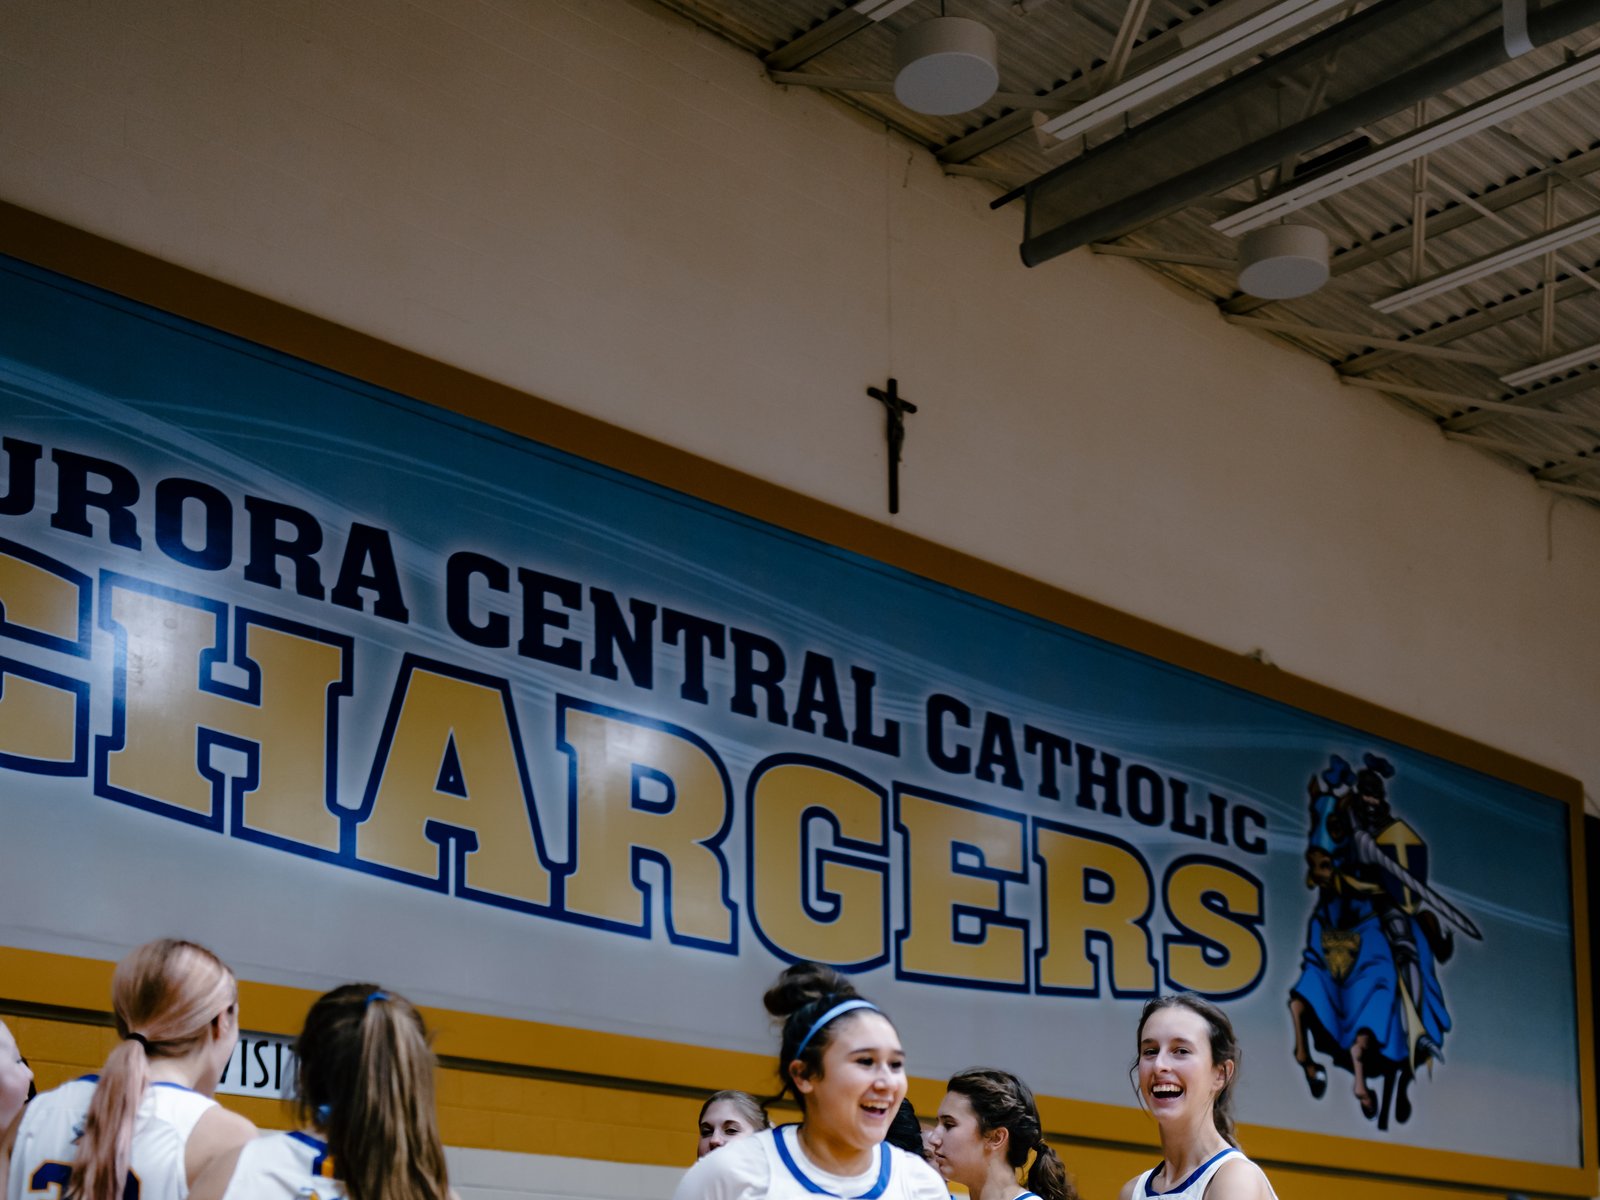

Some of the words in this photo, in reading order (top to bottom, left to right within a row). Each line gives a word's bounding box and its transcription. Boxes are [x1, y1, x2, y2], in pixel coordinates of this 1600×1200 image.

[0, 537, 1267, 1000] CHARGERS
[446, 551, 900, 757] CENTRAL
[926, 693, 1267, 855] CATHOLIC
[219, 1038, 298, 1092] ISI
